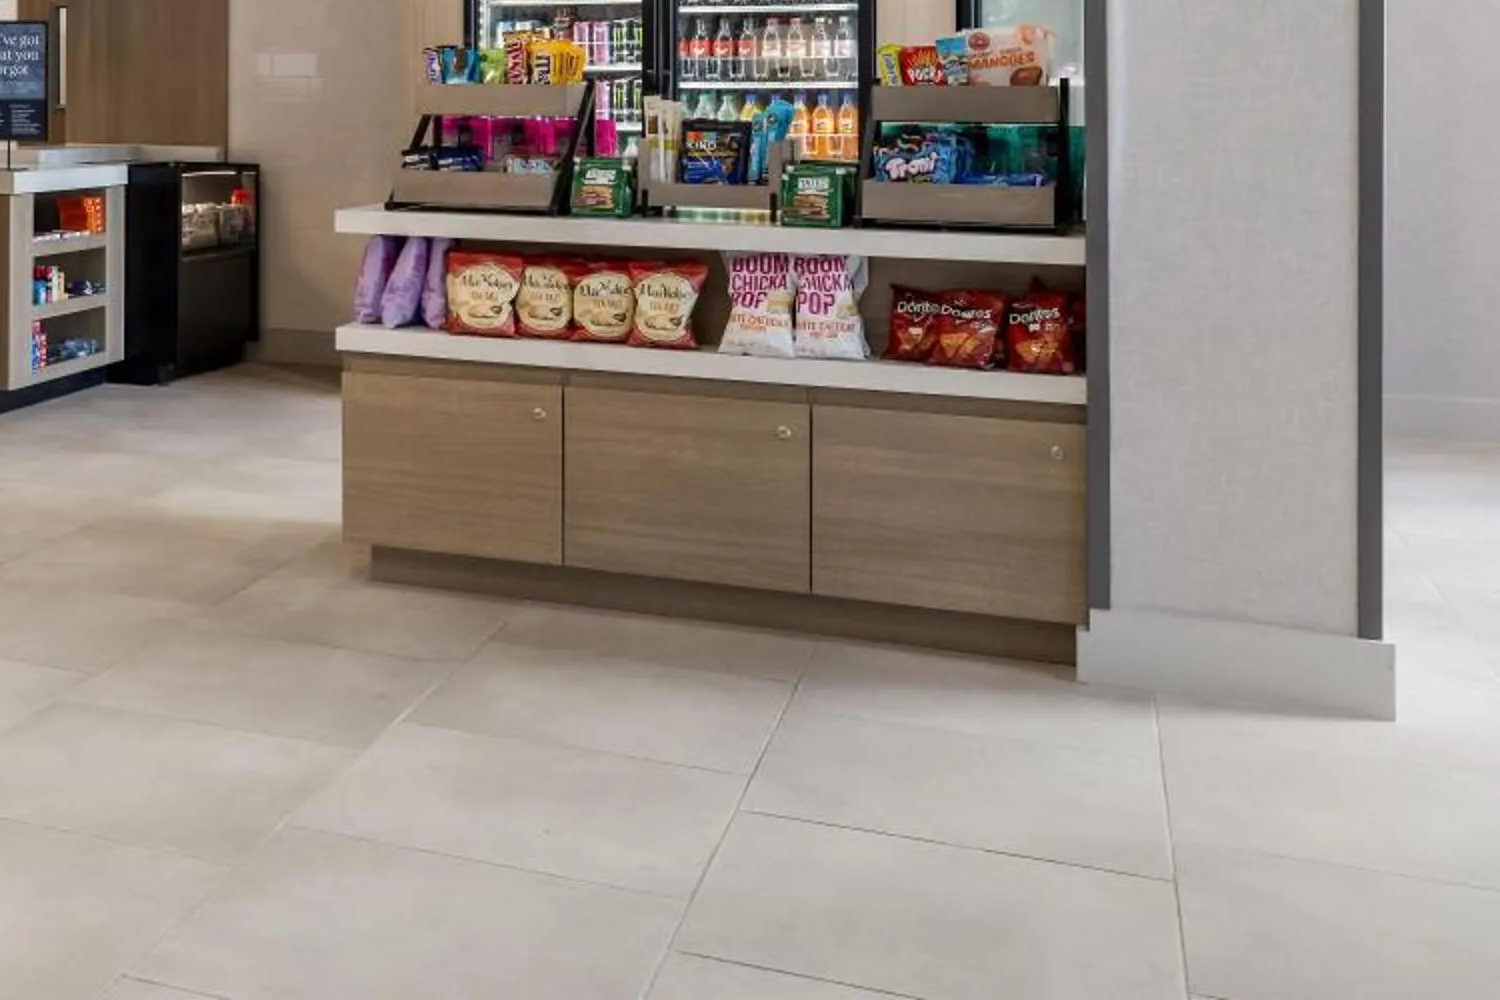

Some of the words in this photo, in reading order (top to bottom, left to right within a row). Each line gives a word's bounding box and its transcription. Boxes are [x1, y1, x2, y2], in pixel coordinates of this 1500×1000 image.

[19, 35, 39, 47] got
[15, 51, 39, 63] you
[731, 274, 788, 292] CHICKA
[797, 291, 835, 315] POP
[897, 300, 941, 314] Dorito
[1008, 307, 1061, 325] Doritos
